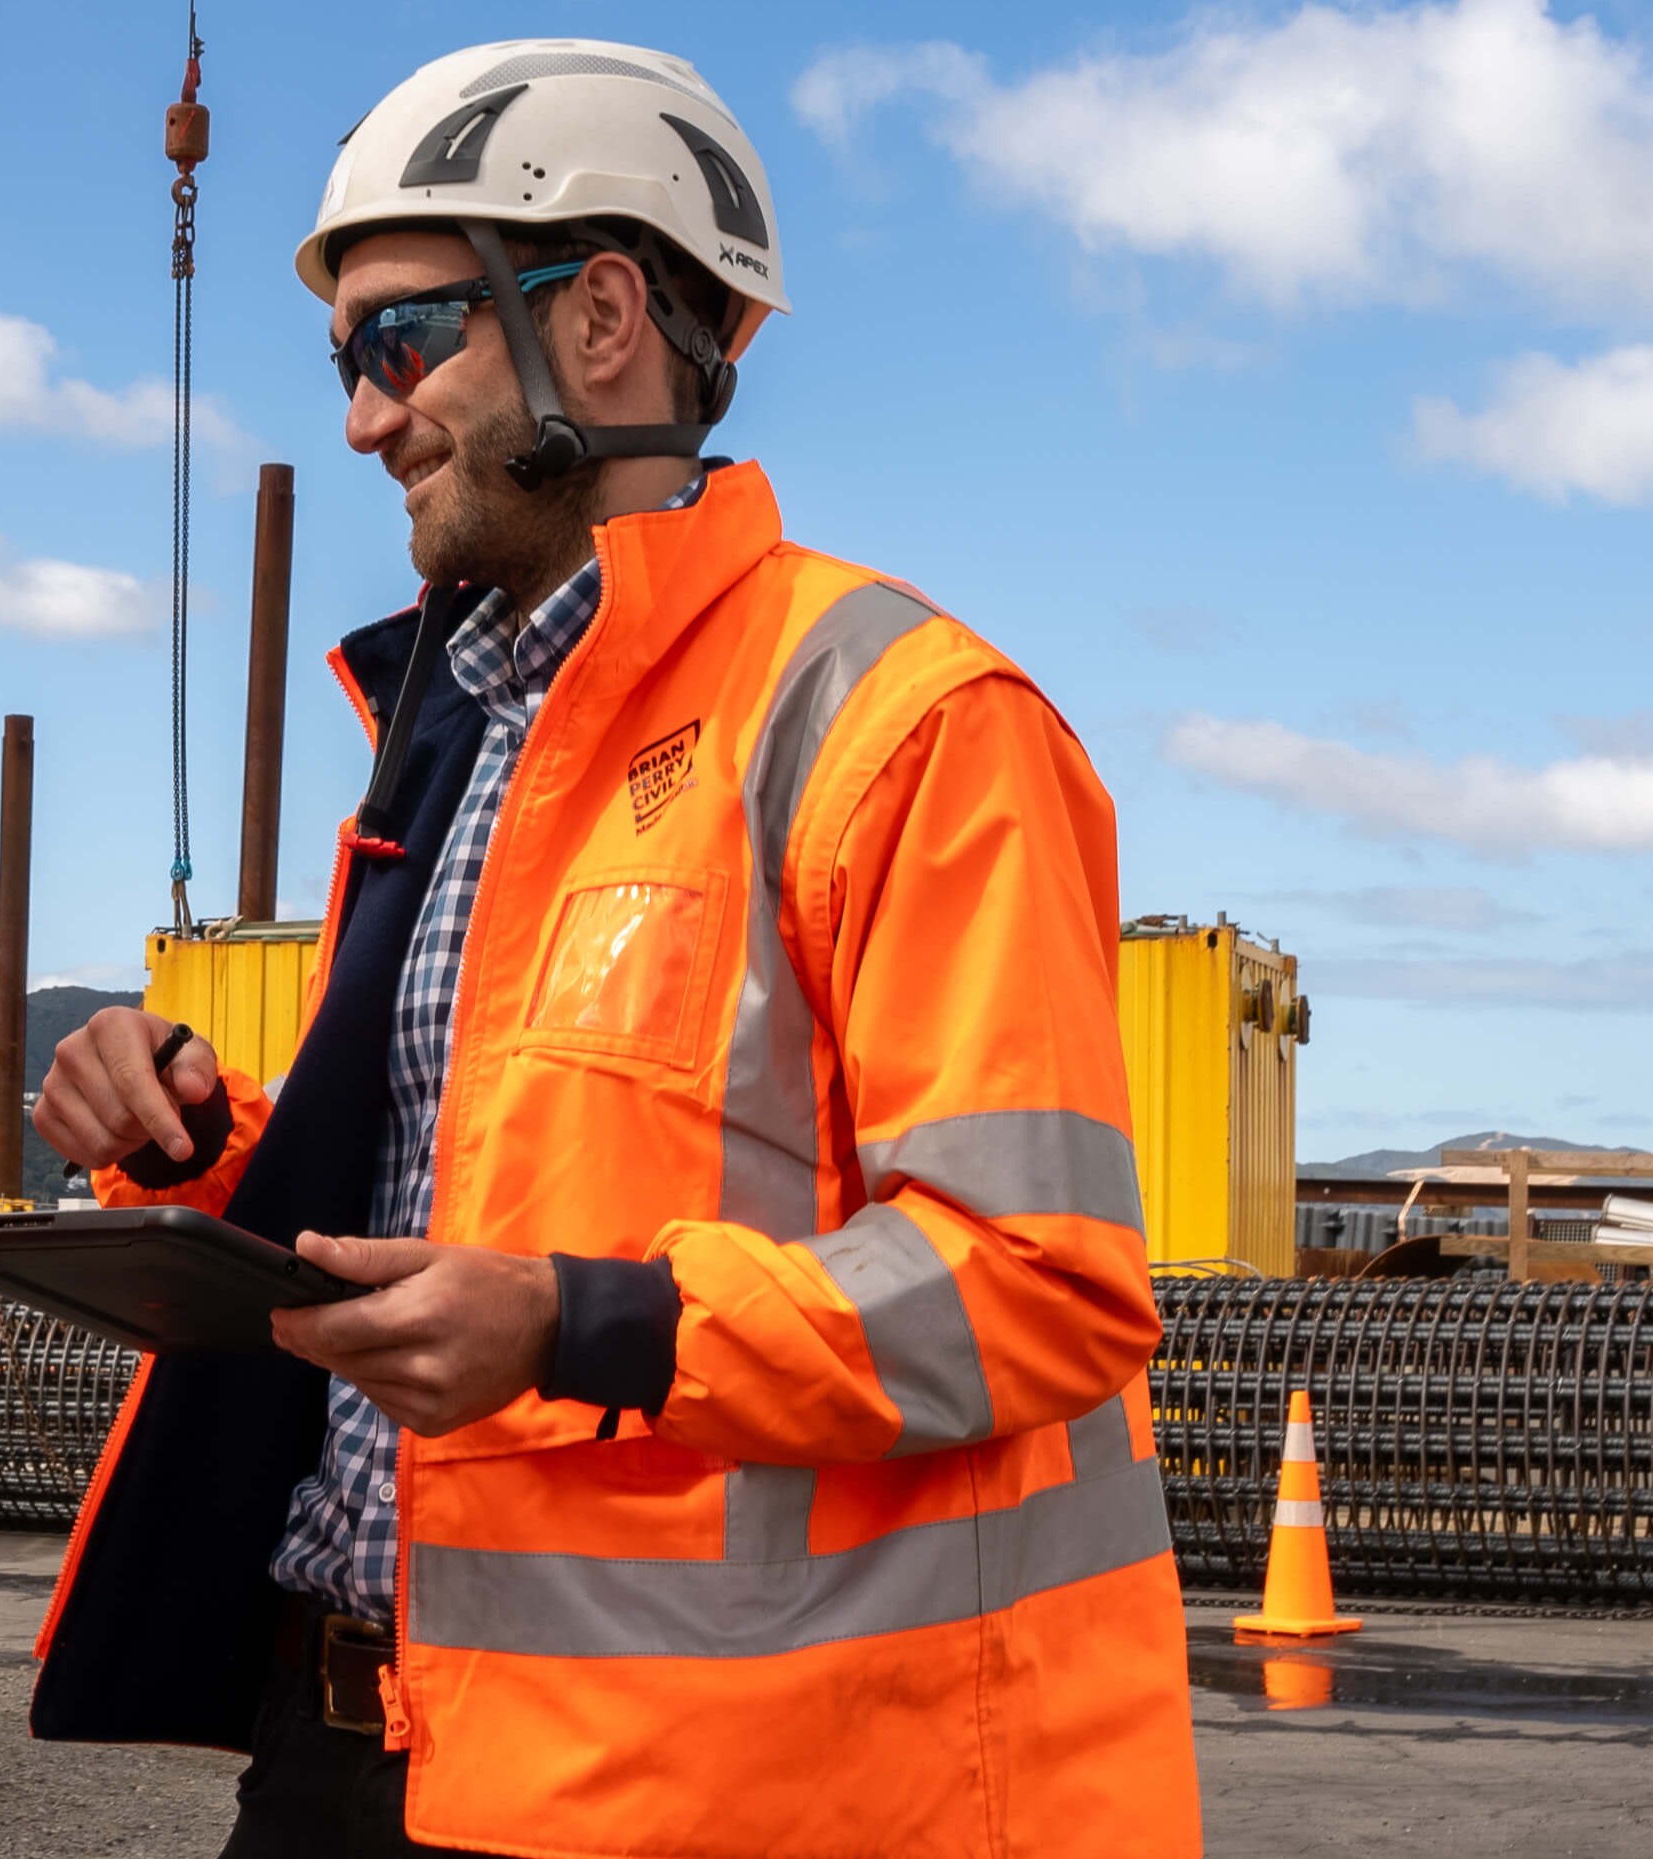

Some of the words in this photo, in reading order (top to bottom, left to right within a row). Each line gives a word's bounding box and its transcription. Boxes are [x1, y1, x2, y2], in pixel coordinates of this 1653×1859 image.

[736, 252, 769, 281] APEX
[628, 740, 685, 782] BRIAN
[630, 753, 685, 797] PERRY
[633, 778, 676, 810] CIVIL
